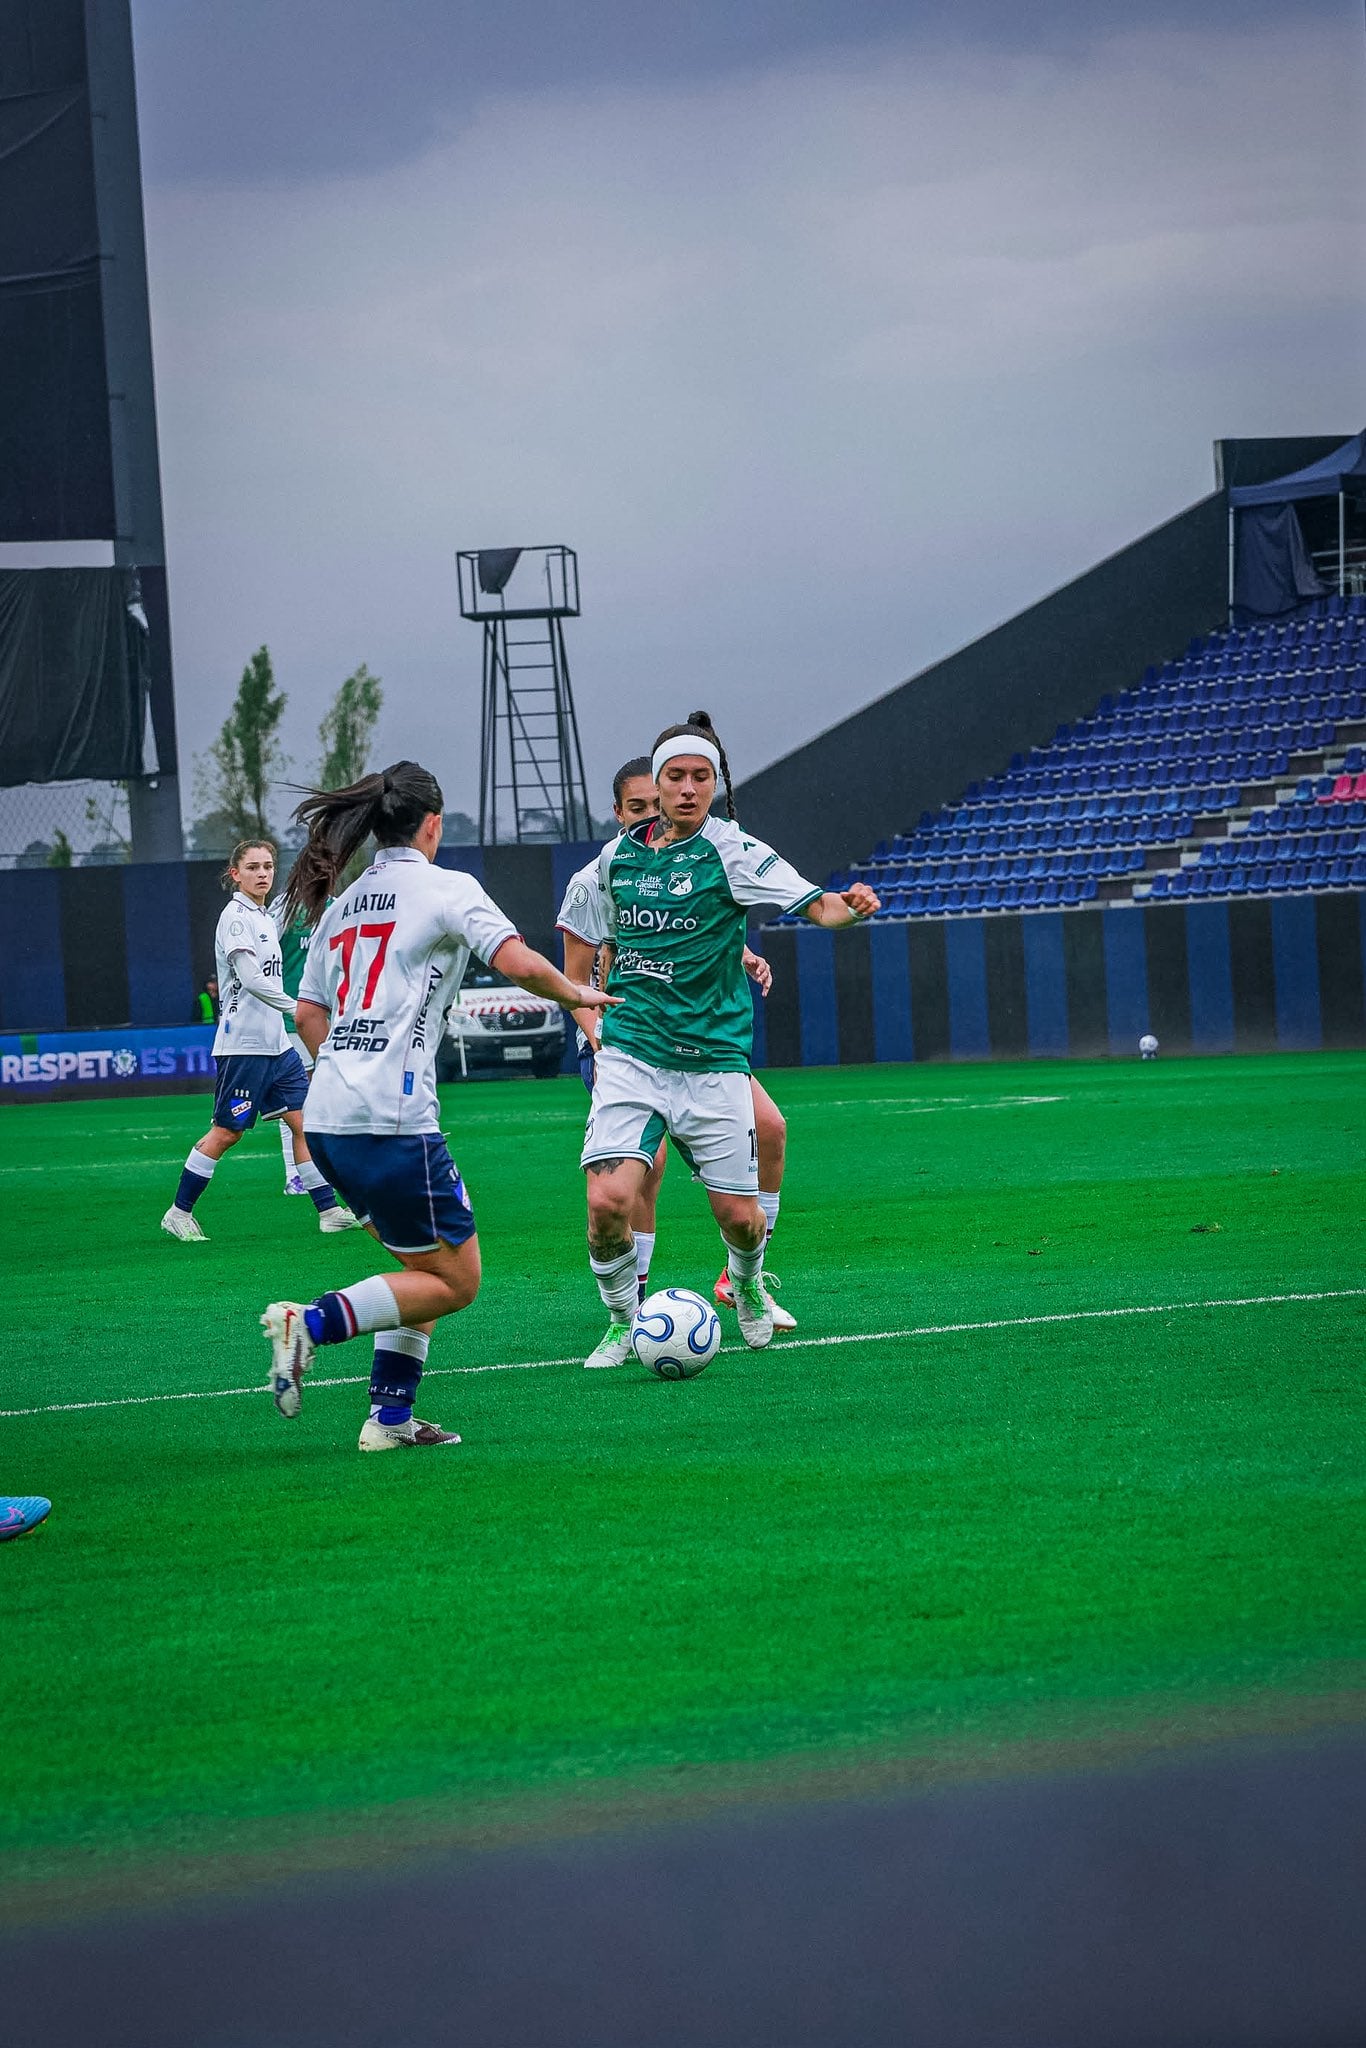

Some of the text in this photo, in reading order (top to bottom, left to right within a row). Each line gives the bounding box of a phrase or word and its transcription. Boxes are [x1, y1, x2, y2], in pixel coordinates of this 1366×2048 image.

[341, 893, 396, 920] A. LATUA
[638, 888, 659, 897] Pizza
[617, 904, 697, 932] play.co
[329, 921, 397, 1016] 77
[141, 1046, 176, 1075] ES
